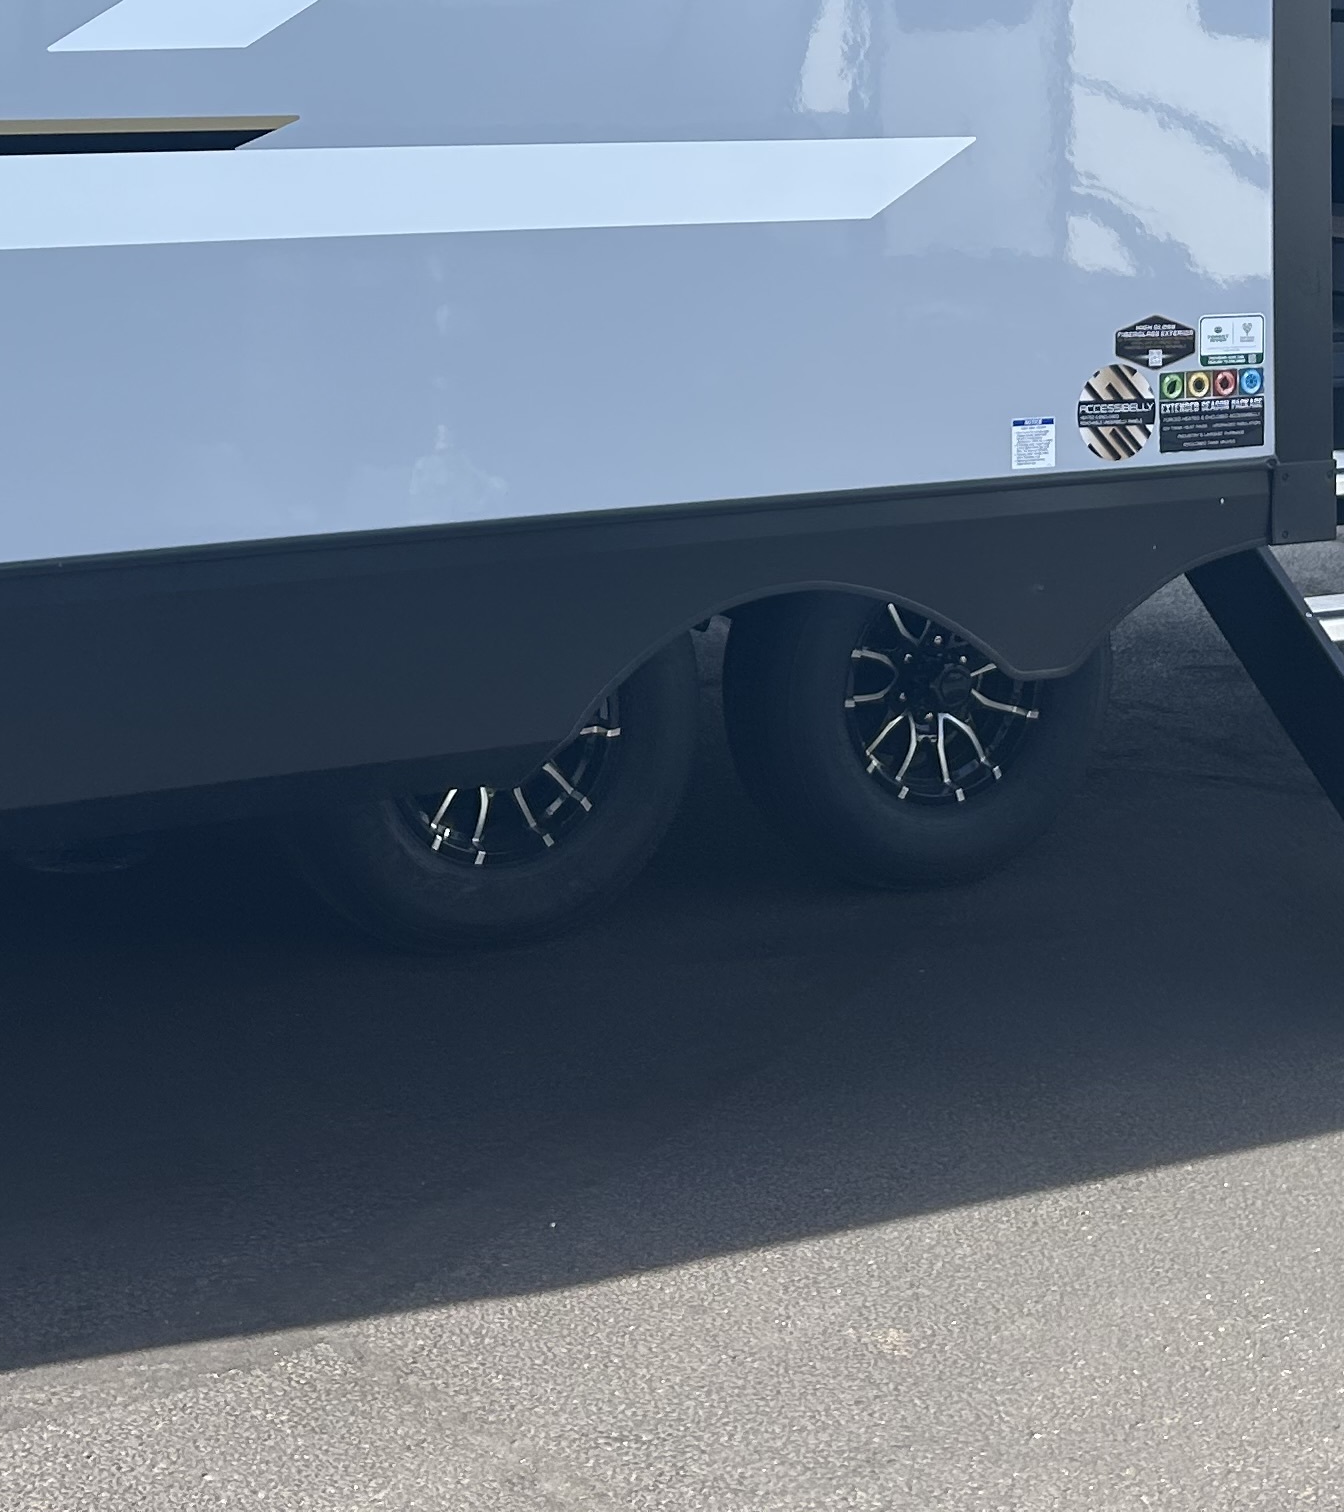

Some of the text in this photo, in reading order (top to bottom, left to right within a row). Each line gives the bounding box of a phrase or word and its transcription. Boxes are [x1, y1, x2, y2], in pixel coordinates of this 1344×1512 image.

[1161, 398, 1263, 414] EXTENDED SEASON PACKAGE
